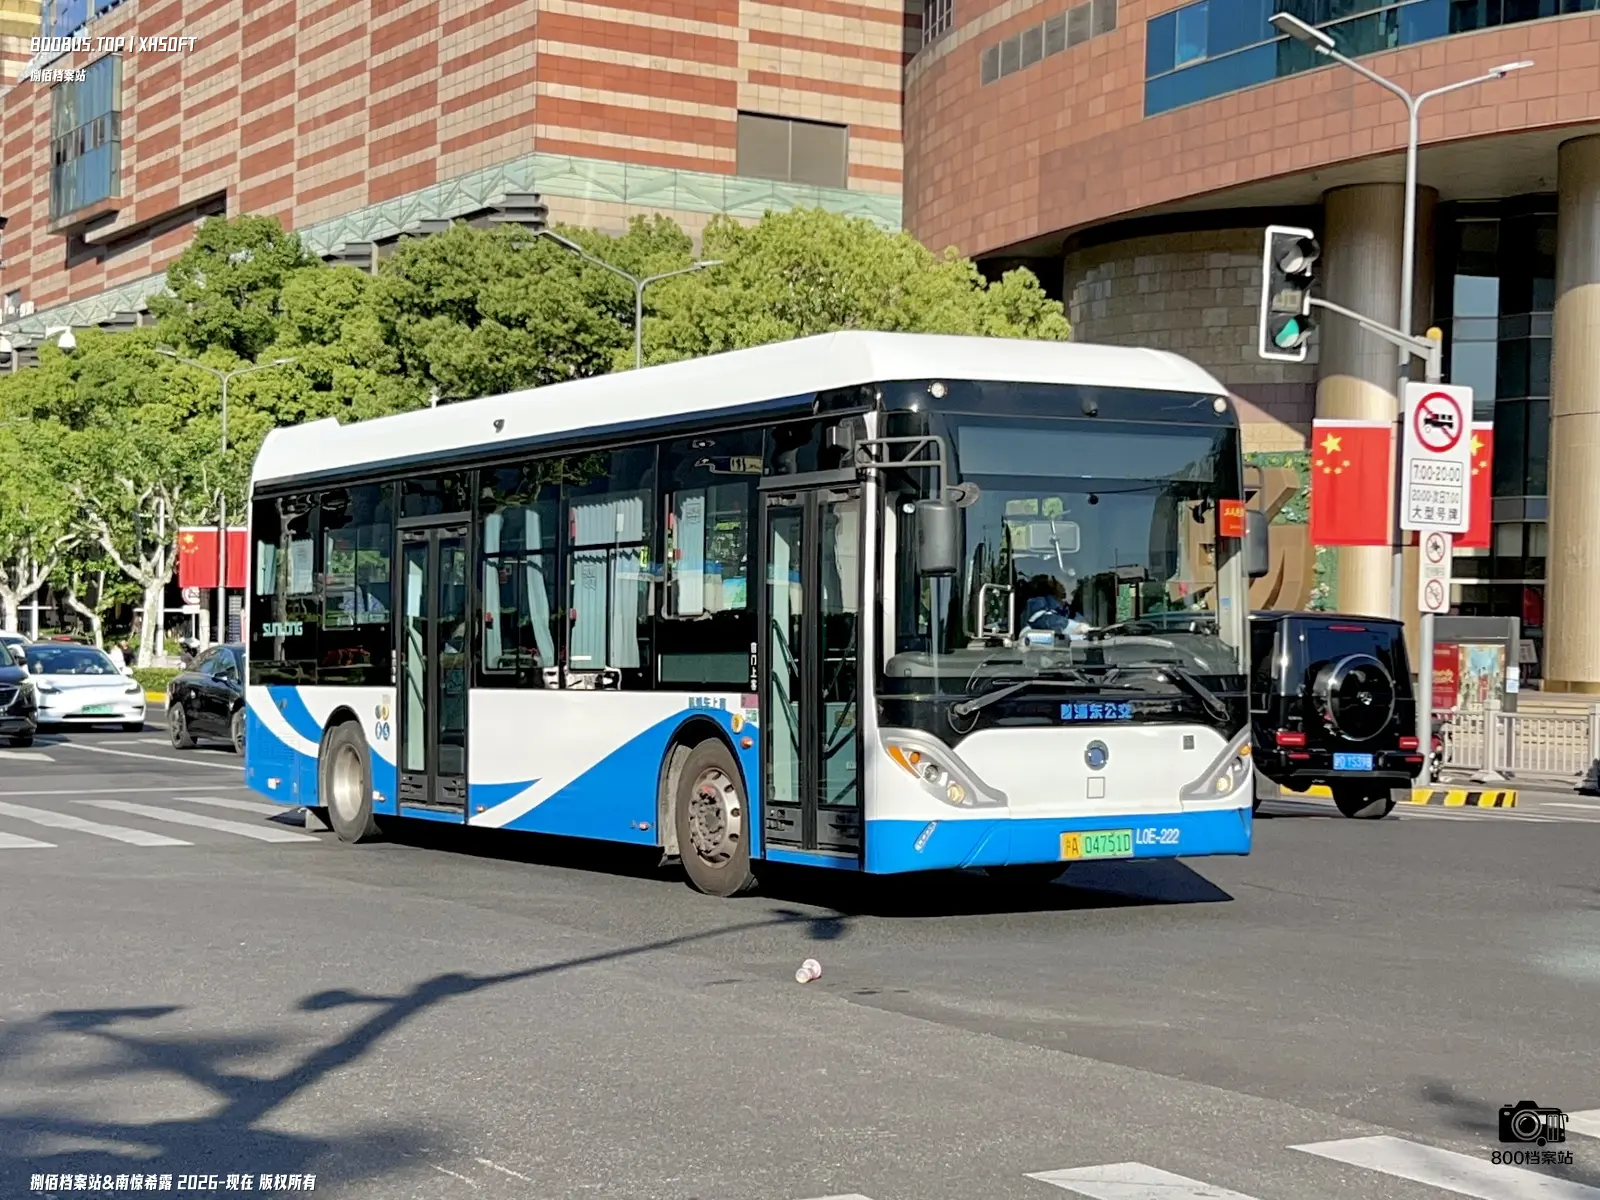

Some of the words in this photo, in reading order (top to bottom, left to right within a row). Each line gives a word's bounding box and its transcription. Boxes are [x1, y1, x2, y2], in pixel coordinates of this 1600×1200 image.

[1412, 505, 1458, 520] 大型号牌
[1084, 833, 1131, 853] 04751D
